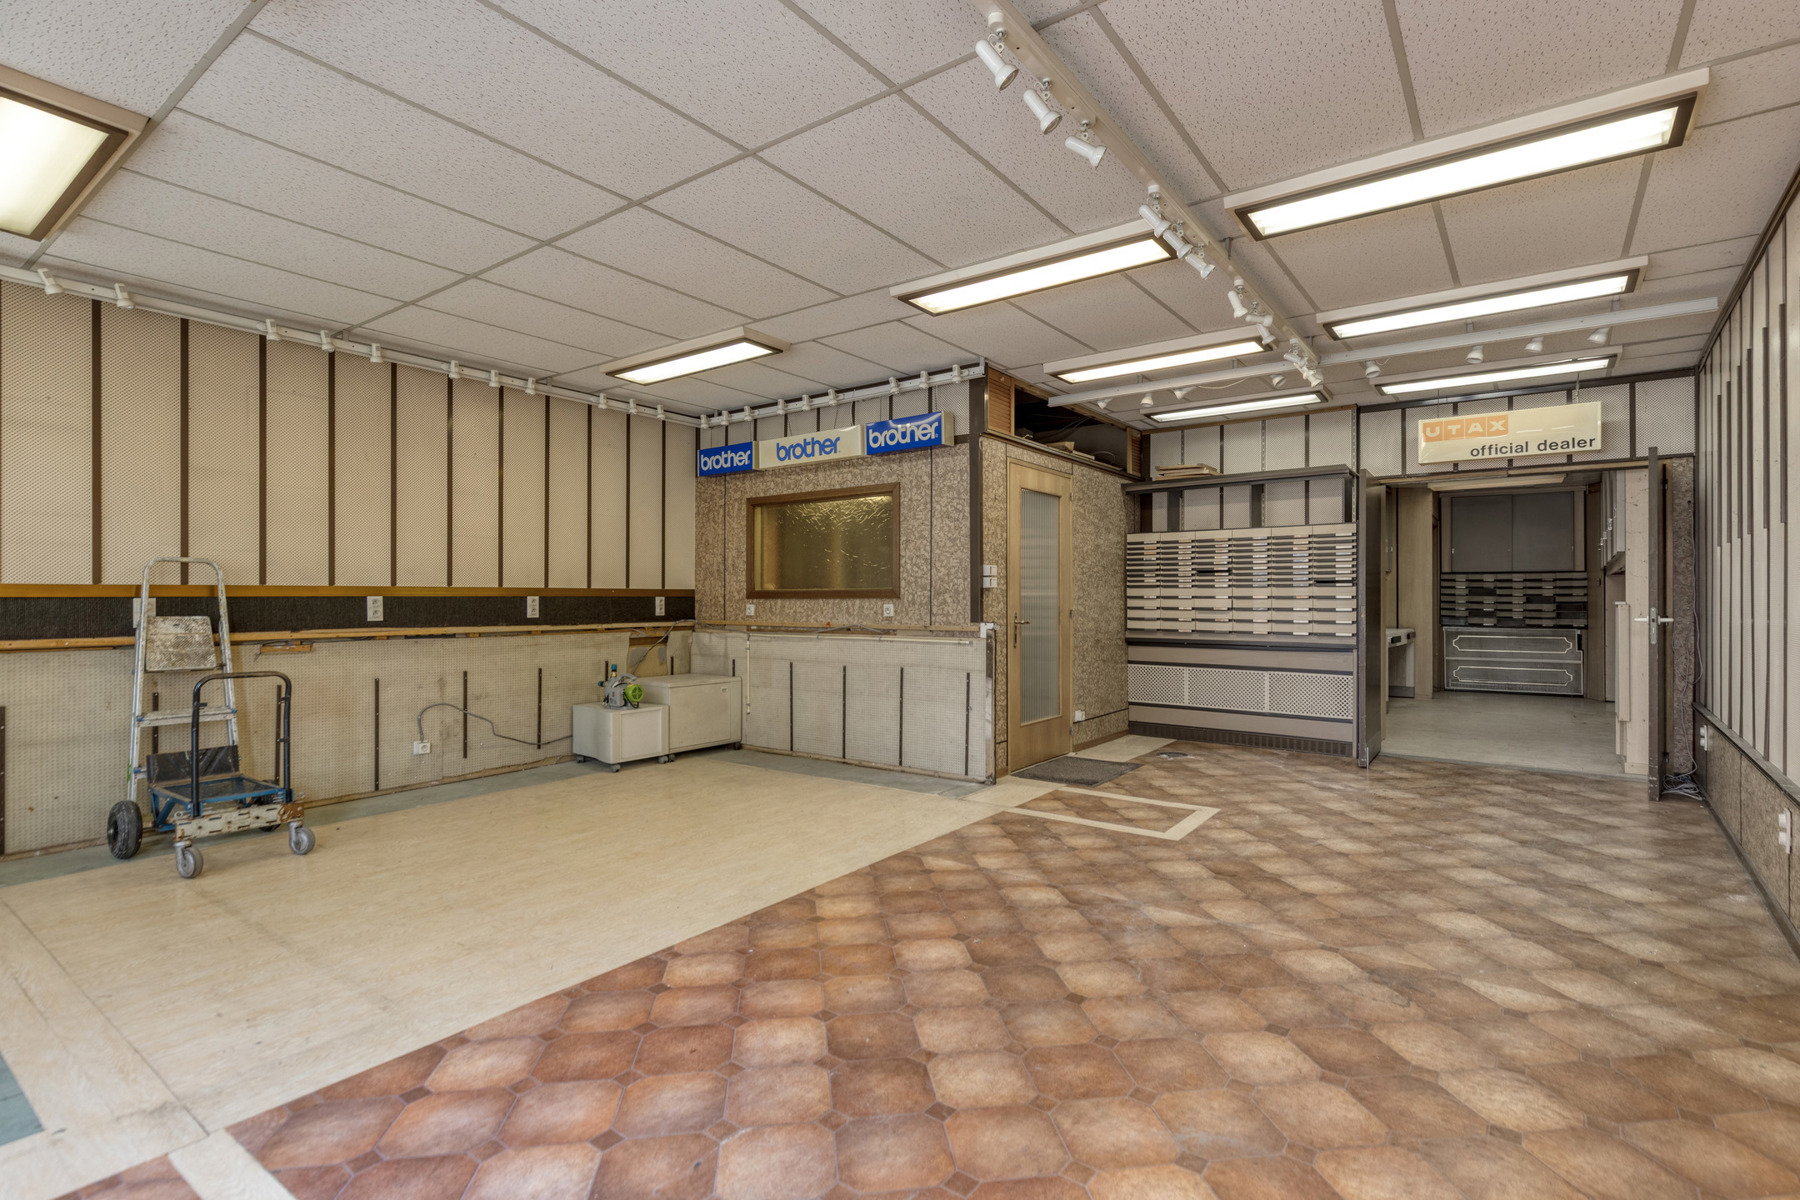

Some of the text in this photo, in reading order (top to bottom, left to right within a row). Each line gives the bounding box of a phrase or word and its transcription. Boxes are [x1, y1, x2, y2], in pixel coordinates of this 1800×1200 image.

[868, 421, 938, 448] brother
[1425, 419, 1507, 438] UTAX
[776, 436, 840, 462] brother
[1470, 437, 1596, 457] official dealer
[701, 450, 751, 471] brother
